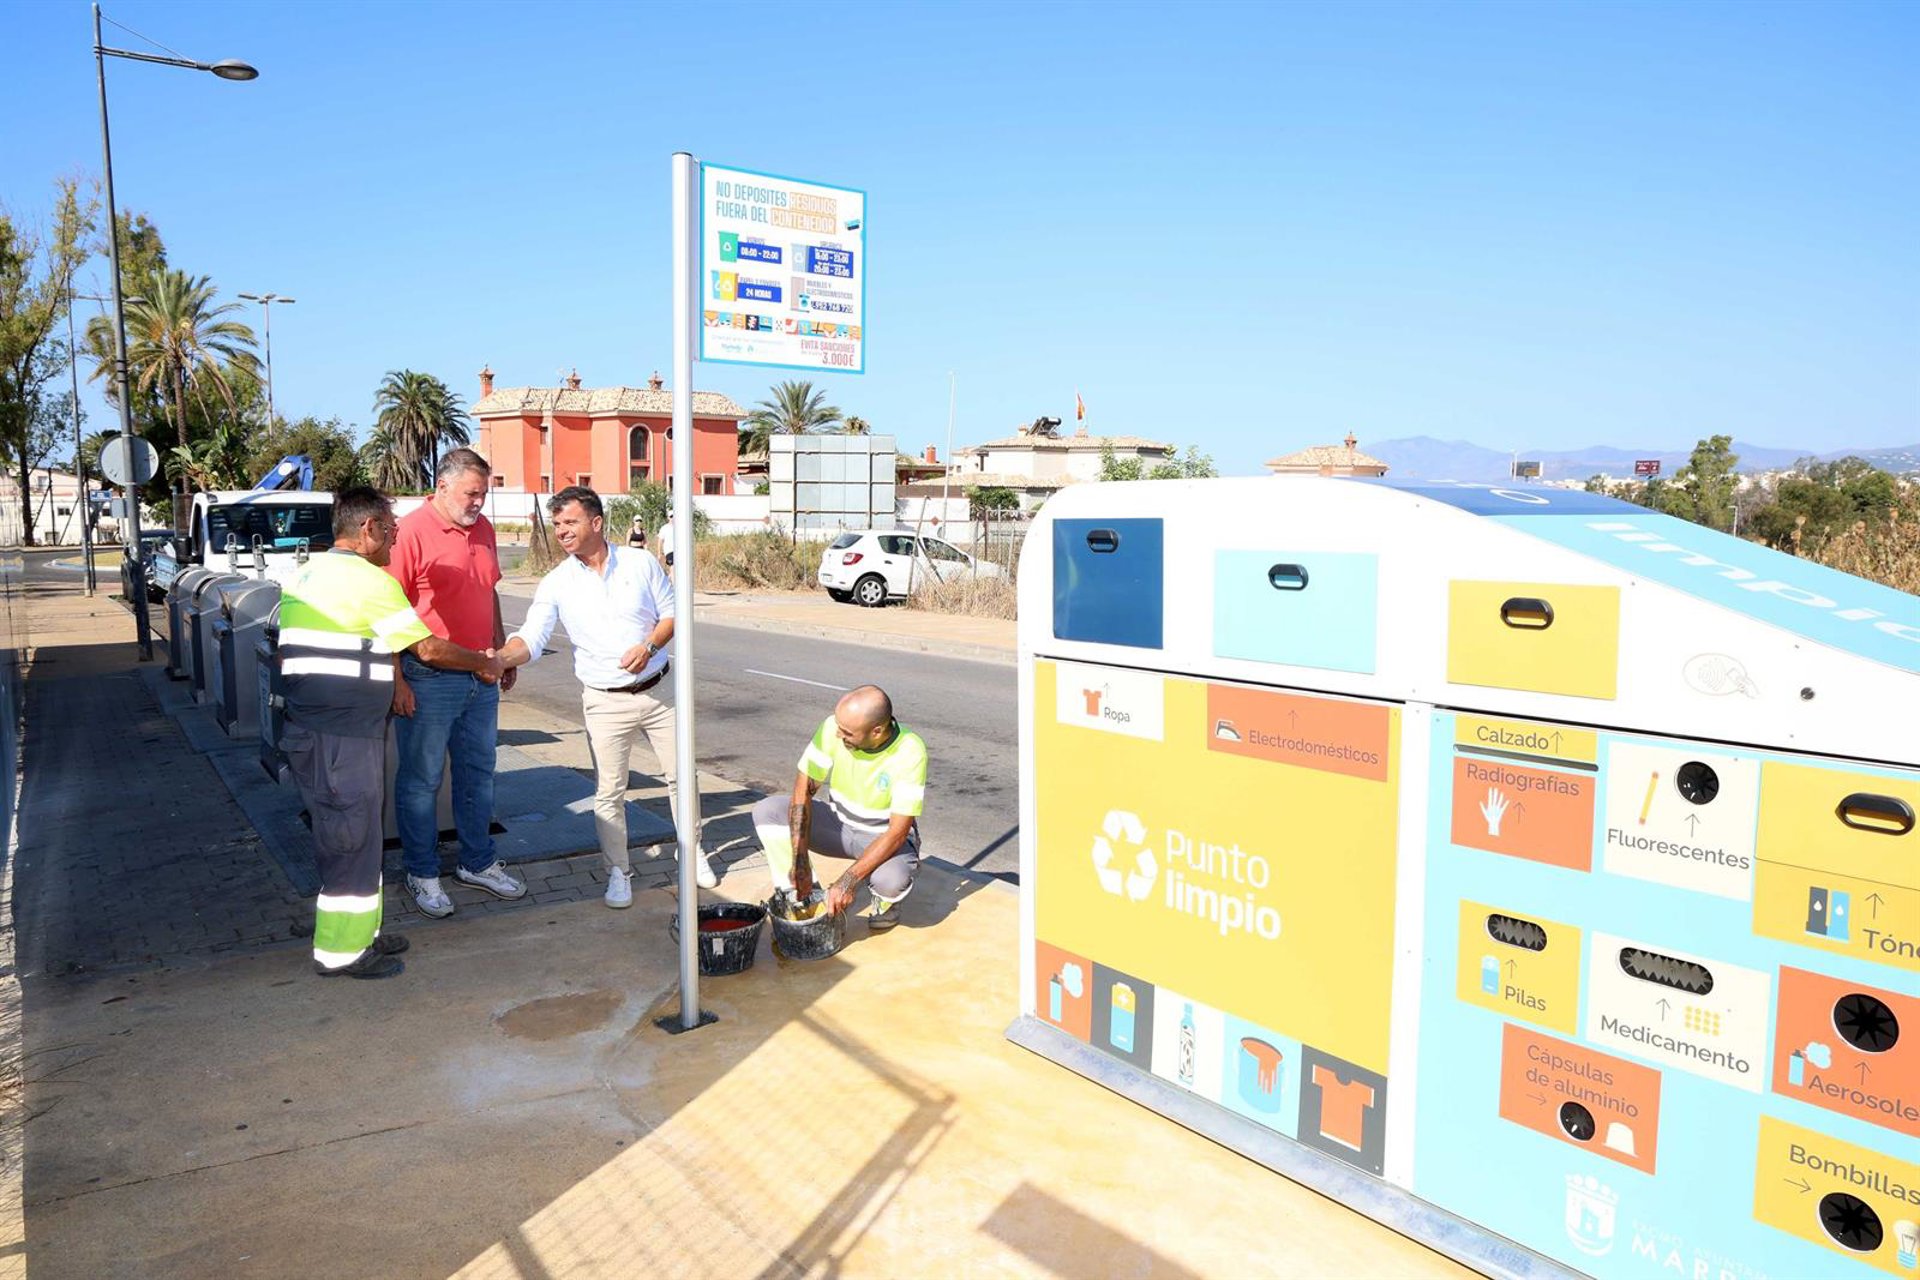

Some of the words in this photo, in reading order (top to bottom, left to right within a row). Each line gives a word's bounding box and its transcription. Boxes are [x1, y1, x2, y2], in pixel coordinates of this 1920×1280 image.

[716, 180, 731, 198] NO
[734, 183, 787, 207] DEPOSITES
[789, 192, 837, 216] RESIDUOS
[716, 200, 748, 221] FUERA
[750, 205, 769, 224] DEL
[771, 208, 836, 234] CONTENEDOR
[745, 288, 753, 297] 24
[800, 339, 819, 350] EVITA
[822, 352, 855, 367] 3.000€
[1103, 705, 1131, 724] Ropa
[1248, 730, 1379, 766] Electrodomésticos
[1476, 725, 1549, 750] Calzado
[1165, 828, 1269, 888] Punto
[1607, 827, 1750, 870] Fluorescentes
[1165, 869, 1281, 940] limpio
[1862, 928, 1920, 960] Tón
[1505, 986, 1547, 1012] Pilas
[1600, 1014, 1750, 1074] Medicamento
[1527, 1044, 1614, 1086] Cápsulas
[1526, 1068, 1550, 1087] de
[1554, 1078, 1639, 1119] aluminio
[1808, 1074, 1920, 1121] Aerosole
[1788, 1144, 1920, 1206] Bombillas
